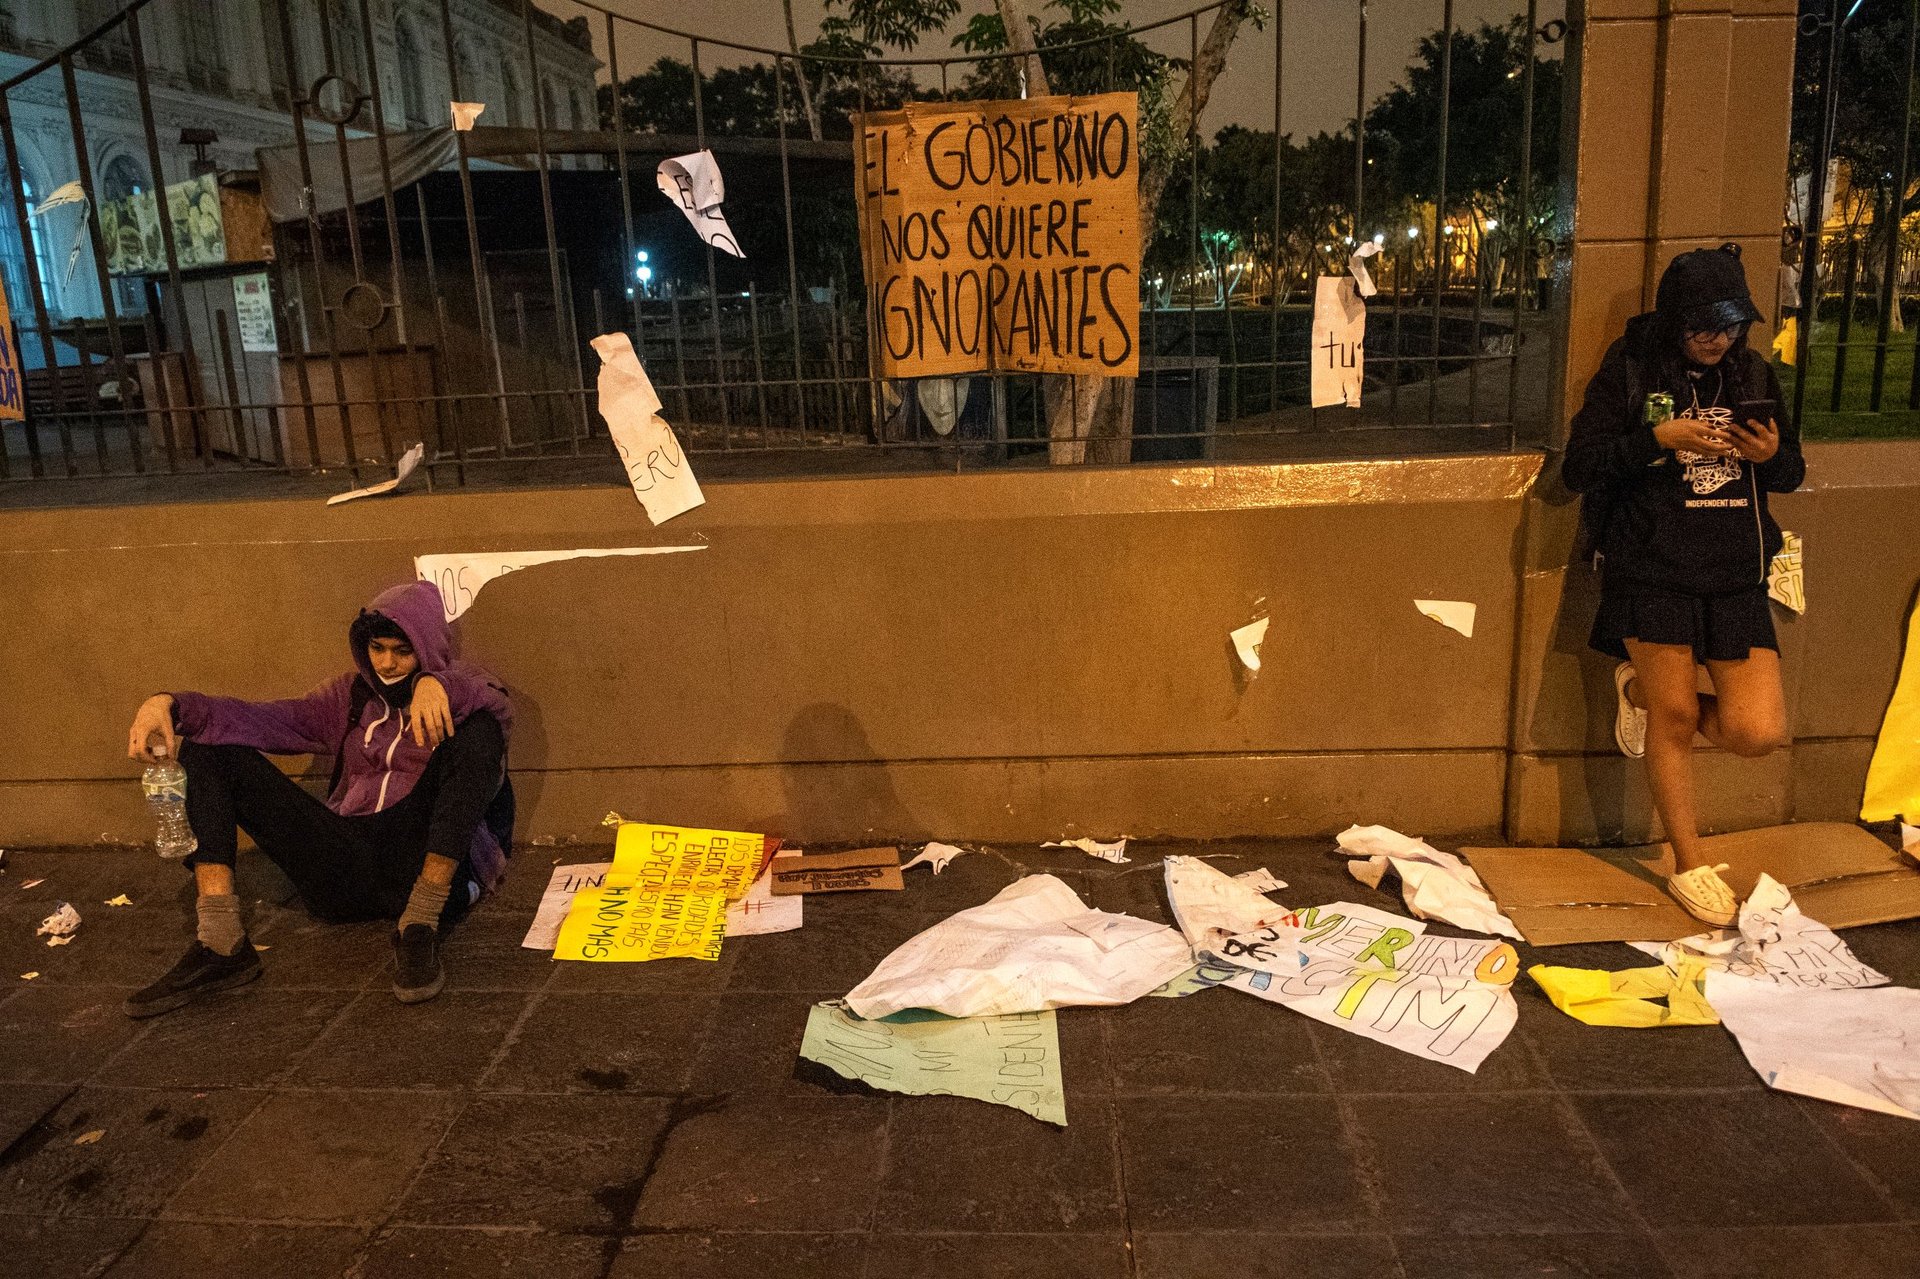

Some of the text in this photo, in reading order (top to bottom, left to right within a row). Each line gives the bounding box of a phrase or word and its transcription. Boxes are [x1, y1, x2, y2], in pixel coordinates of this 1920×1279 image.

[924, 111, 1130, 191] GOBIERNO
[881, 198, 1093, 266] NOS QUIERE
[874, 263, 1132, 367] IGNORANTES
[1685, 498, 1748, 508] INDEPENDENT BONES
[597, 898, 629, 922] NO
[660, 893, 687, 921] HAN
[581, 923, 619, 960] MÁS
